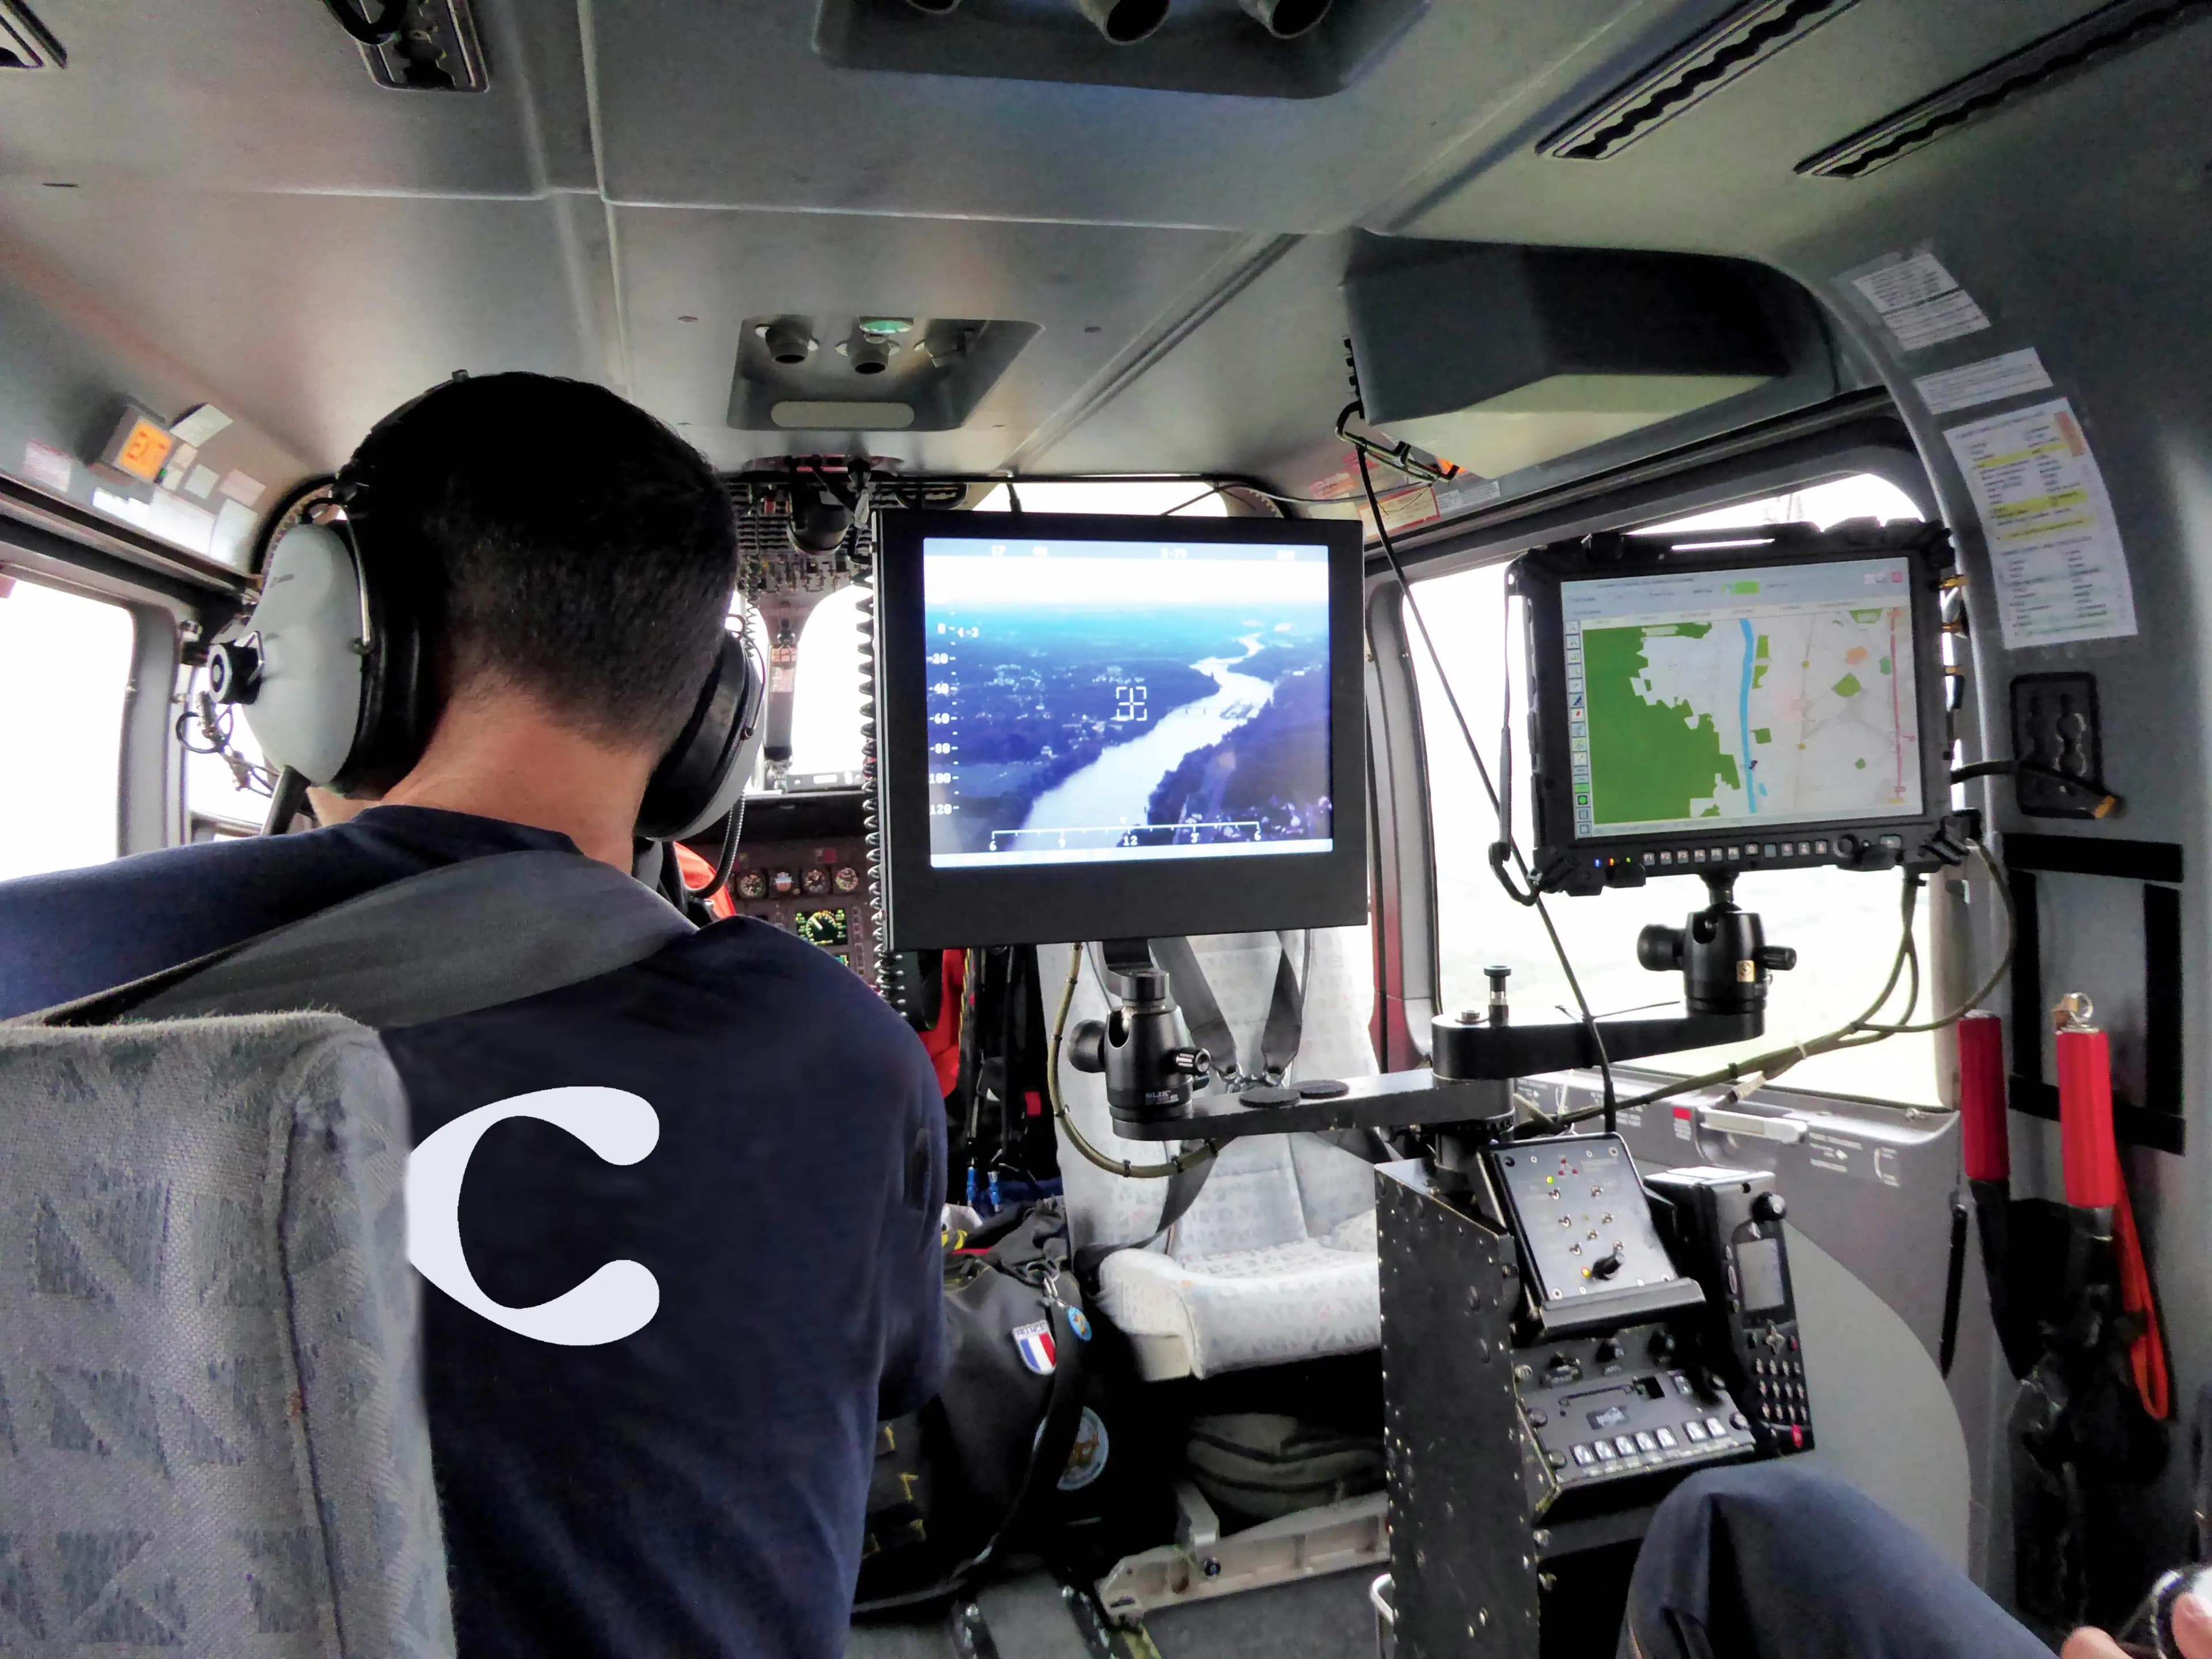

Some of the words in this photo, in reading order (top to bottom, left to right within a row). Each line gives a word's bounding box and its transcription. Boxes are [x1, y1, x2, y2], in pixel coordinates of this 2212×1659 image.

[930, 804, 952, 815] 120
[990, 840, 997, 851] 6
[1123, 835, 1138, 846] 12
[1254, 831, 1262, 841] 6
[1017, 1321, 1047, 1335] FRANCE
